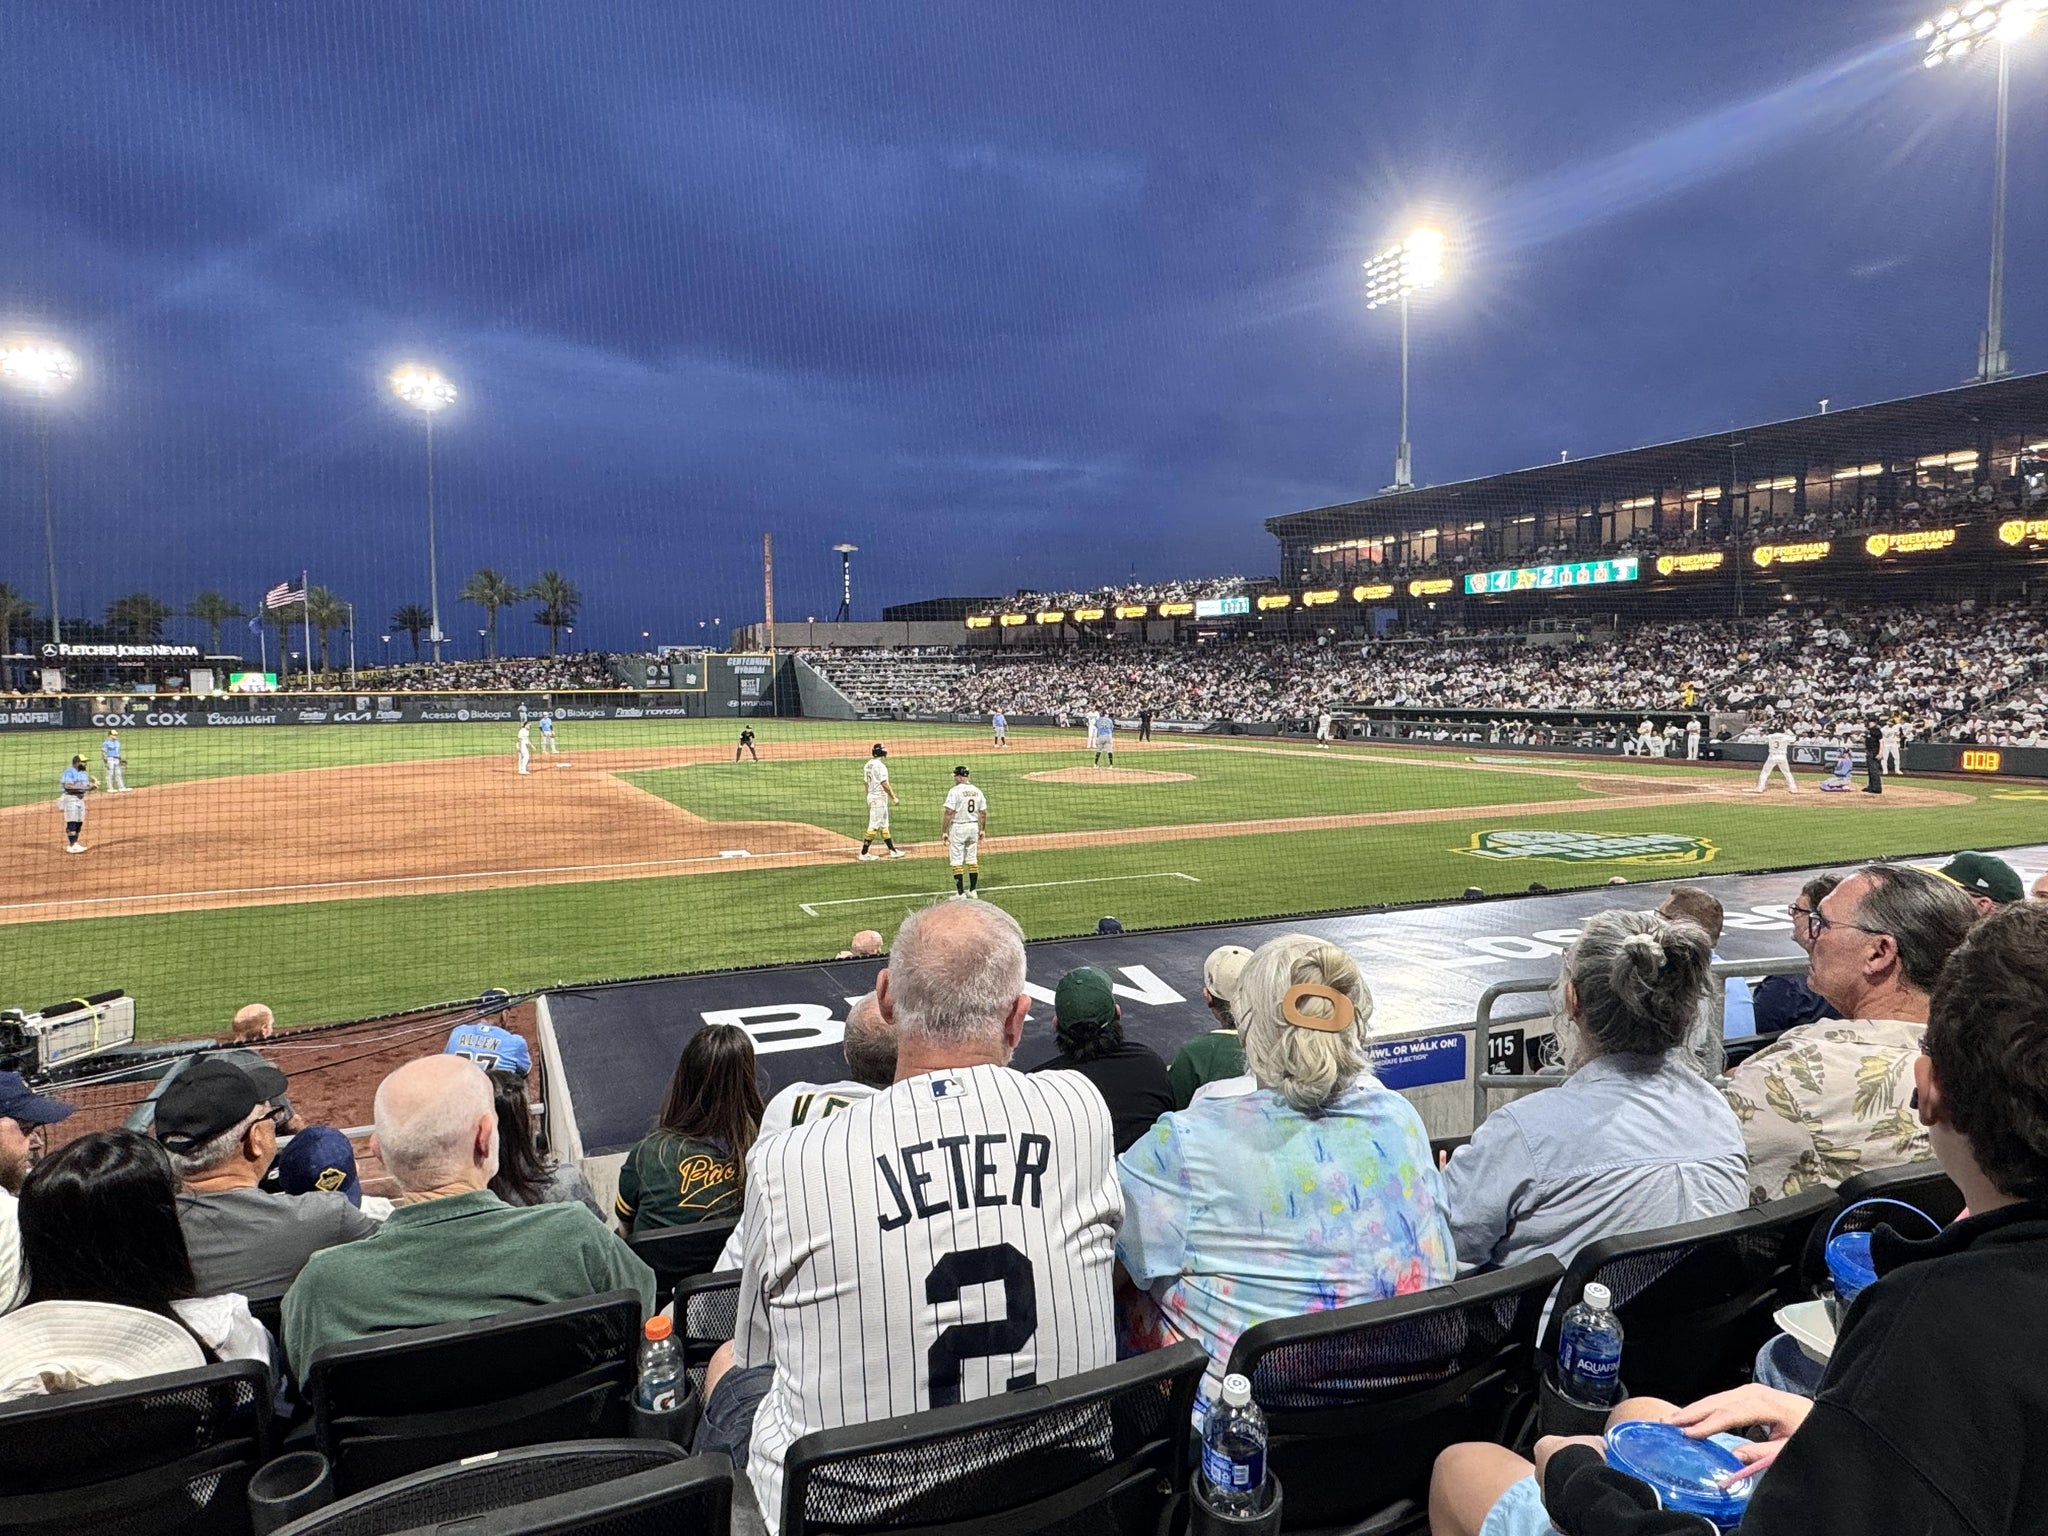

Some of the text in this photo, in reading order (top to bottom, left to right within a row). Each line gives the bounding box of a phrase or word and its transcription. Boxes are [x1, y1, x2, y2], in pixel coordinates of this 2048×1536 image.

[1889, 529, 1956, 546] FRIEDMAN
[1773, 542, 1831, 557] FRIEDMAN
[1540, 568, 1554, 585] 2
[59, 644, 199, 658] FLETCHER JONES NEVADA
[727, 657, 771, 666] CENTENNIAL
[11, 712, 49, 724] ROOFER
[145, 712, 188, 726] COX
[207, 712, 277, 725] Coors LIGHT
[420, 709, 512, 720] Acesso Biologics
[567, 708, 606, 718] Biologics
[645, 708, 686, 716] TOYOTA
[92, 713, 136, 726] COX
[968, 799, 975, 813] 8
[459, 1034, 500, 1050] ALLEN
[1392, 1045, 1408, 1055] OR
[1409, 1040, 1438, 1053] WALK
[1439, 1038, 1458, 1049] ON!
[1488, 1035, 1514, 1059] 115
[455, 1051, 500, 1071] 7
[877, 1132, 1052, 1232] JETER
[925, 1242, 1039, 1409] 2
